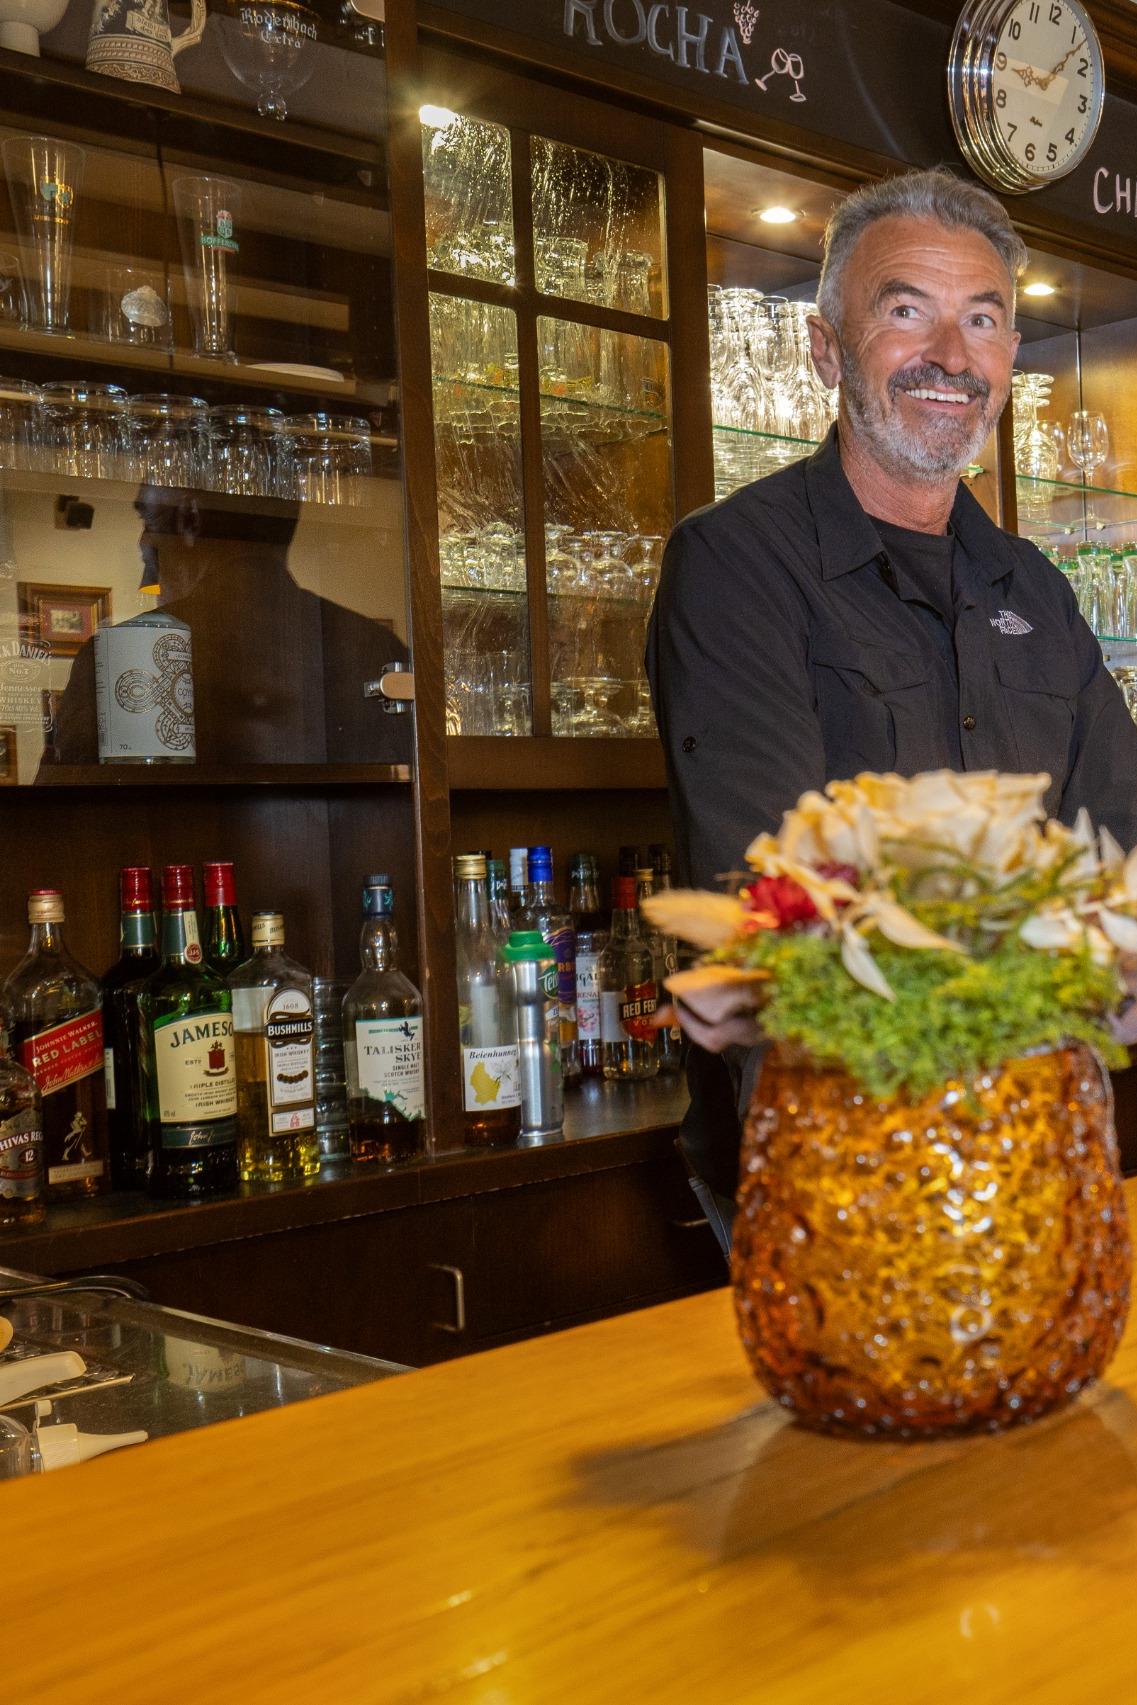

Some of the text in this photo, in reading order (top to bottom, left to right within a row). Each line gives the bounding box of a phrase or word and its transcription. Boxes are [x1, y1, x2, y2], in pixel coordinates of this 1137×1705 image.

[1030, 2, 1040, 23] 11
[1049, 4, 1062, 25] 12
[1008, 19, 1021, 40] 10
[1071, 26, 1077, 44] 1
[260, 31, 301, 49] Extra
[564, 0, 749, 85] ROCHA
[996, 52, 1007, 71] 9
[1077, 58, 1088, 78] 2
[996, 89, 1007, 108] 8
[1078, 95, 1087, 113] 3
[1007, 122, 1017, 142] 7
[1065, 128, 1075, 145] 4
[1025, 143, 1036, 161] 6
[1046, 143, 1057, 162] 5
[623, 1002, 641, 1018] RED
[36, 1021, 97, 1054] JOHNNIE WALKER
[267, 1021, 312, 1036] BUSHMILLS
[32, 1030, 102, 1068] RED LABEL
[363, 1042, 421, 1056] TALISKER
[395, 1051, 421, 1063] SKYE
[25, 1149, 34, 1162] 12
